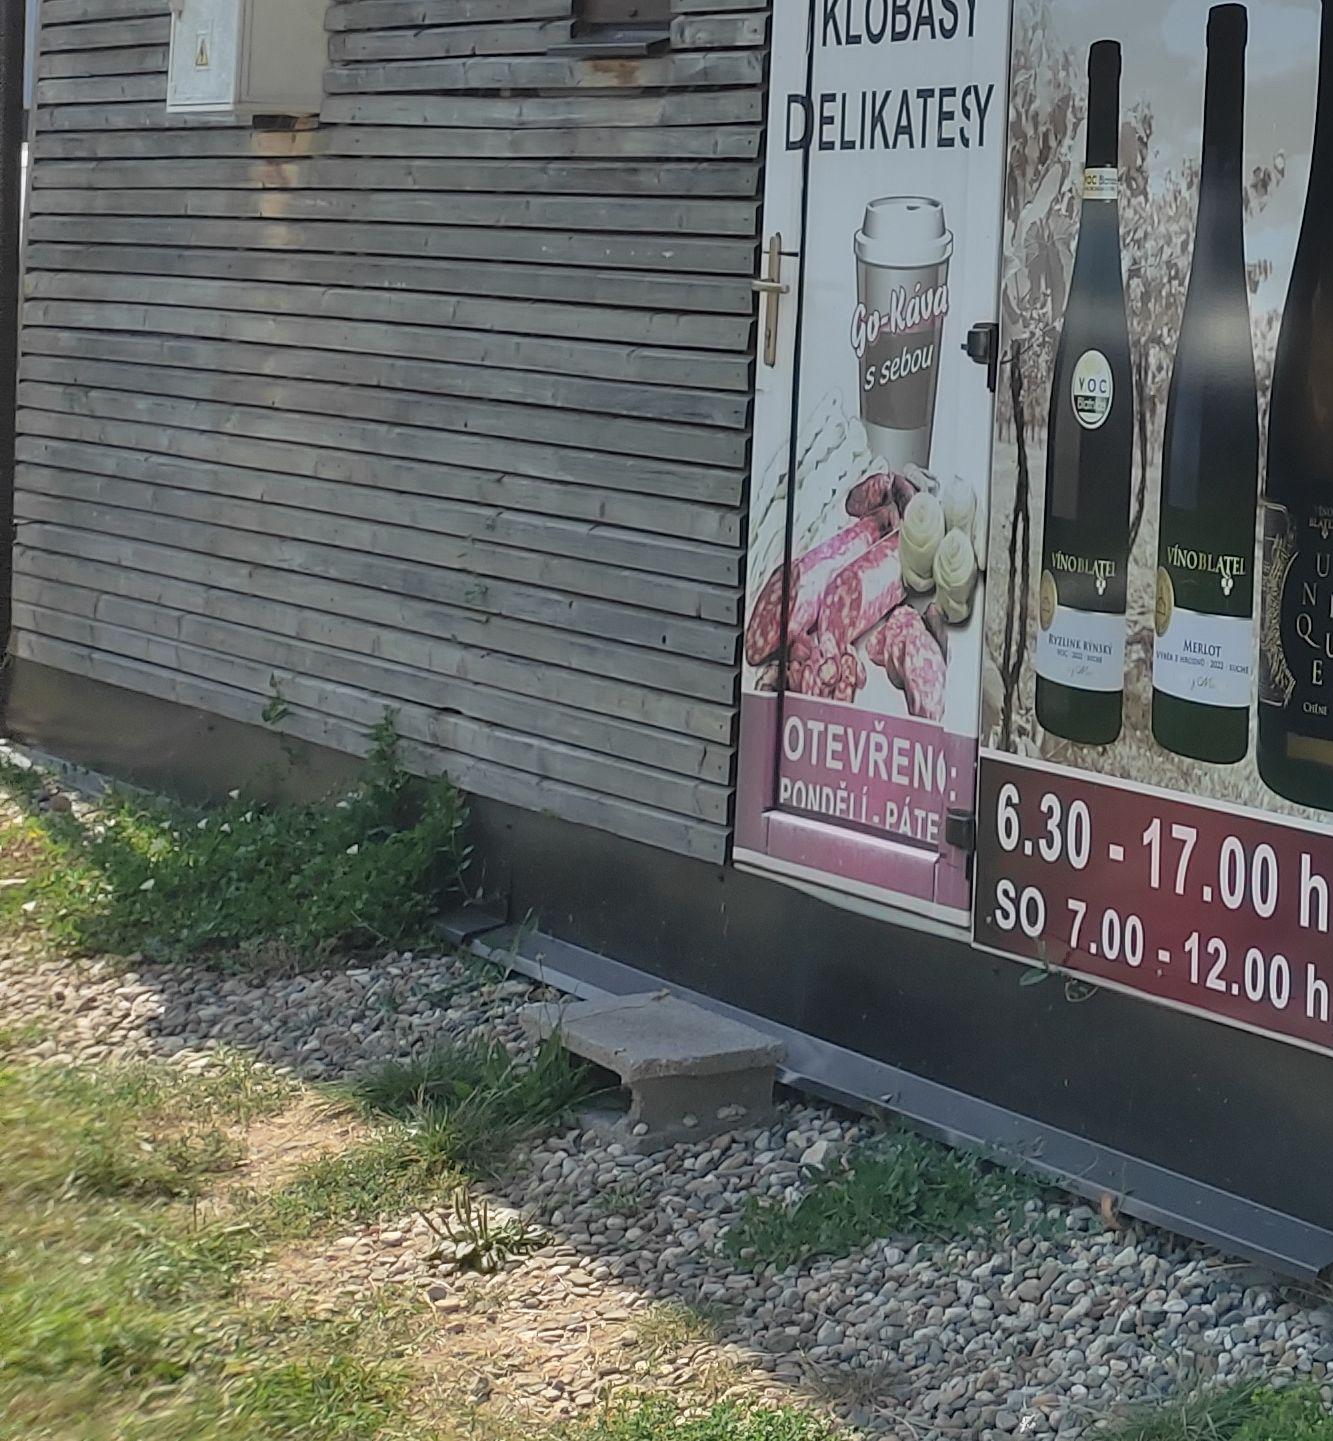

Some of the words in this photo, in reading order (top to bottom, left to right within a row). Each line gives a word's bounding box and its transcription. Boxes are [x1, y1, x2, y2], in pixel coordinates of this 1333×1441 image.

[785, 83, 995, 152] DELIKATESY
[850, 281, 949, 359] Go-Káva
[864, 365, 876, 391] s
[879, 344, 934, 385] sebou
[1079, 377, 1107, 393] VOC
[1183, 639, 1222, 657] MERLOT
[885, 796, 940, 845] PÁTE
[997, 782, 1091, 870] 6.30
[1142, 816, 1279, 919] 17.00
[995, 877, 1046, 938] SO
[1066, 898, 1145, 968] 7.00
[1184, 931, 1291, 1010] 12.00
